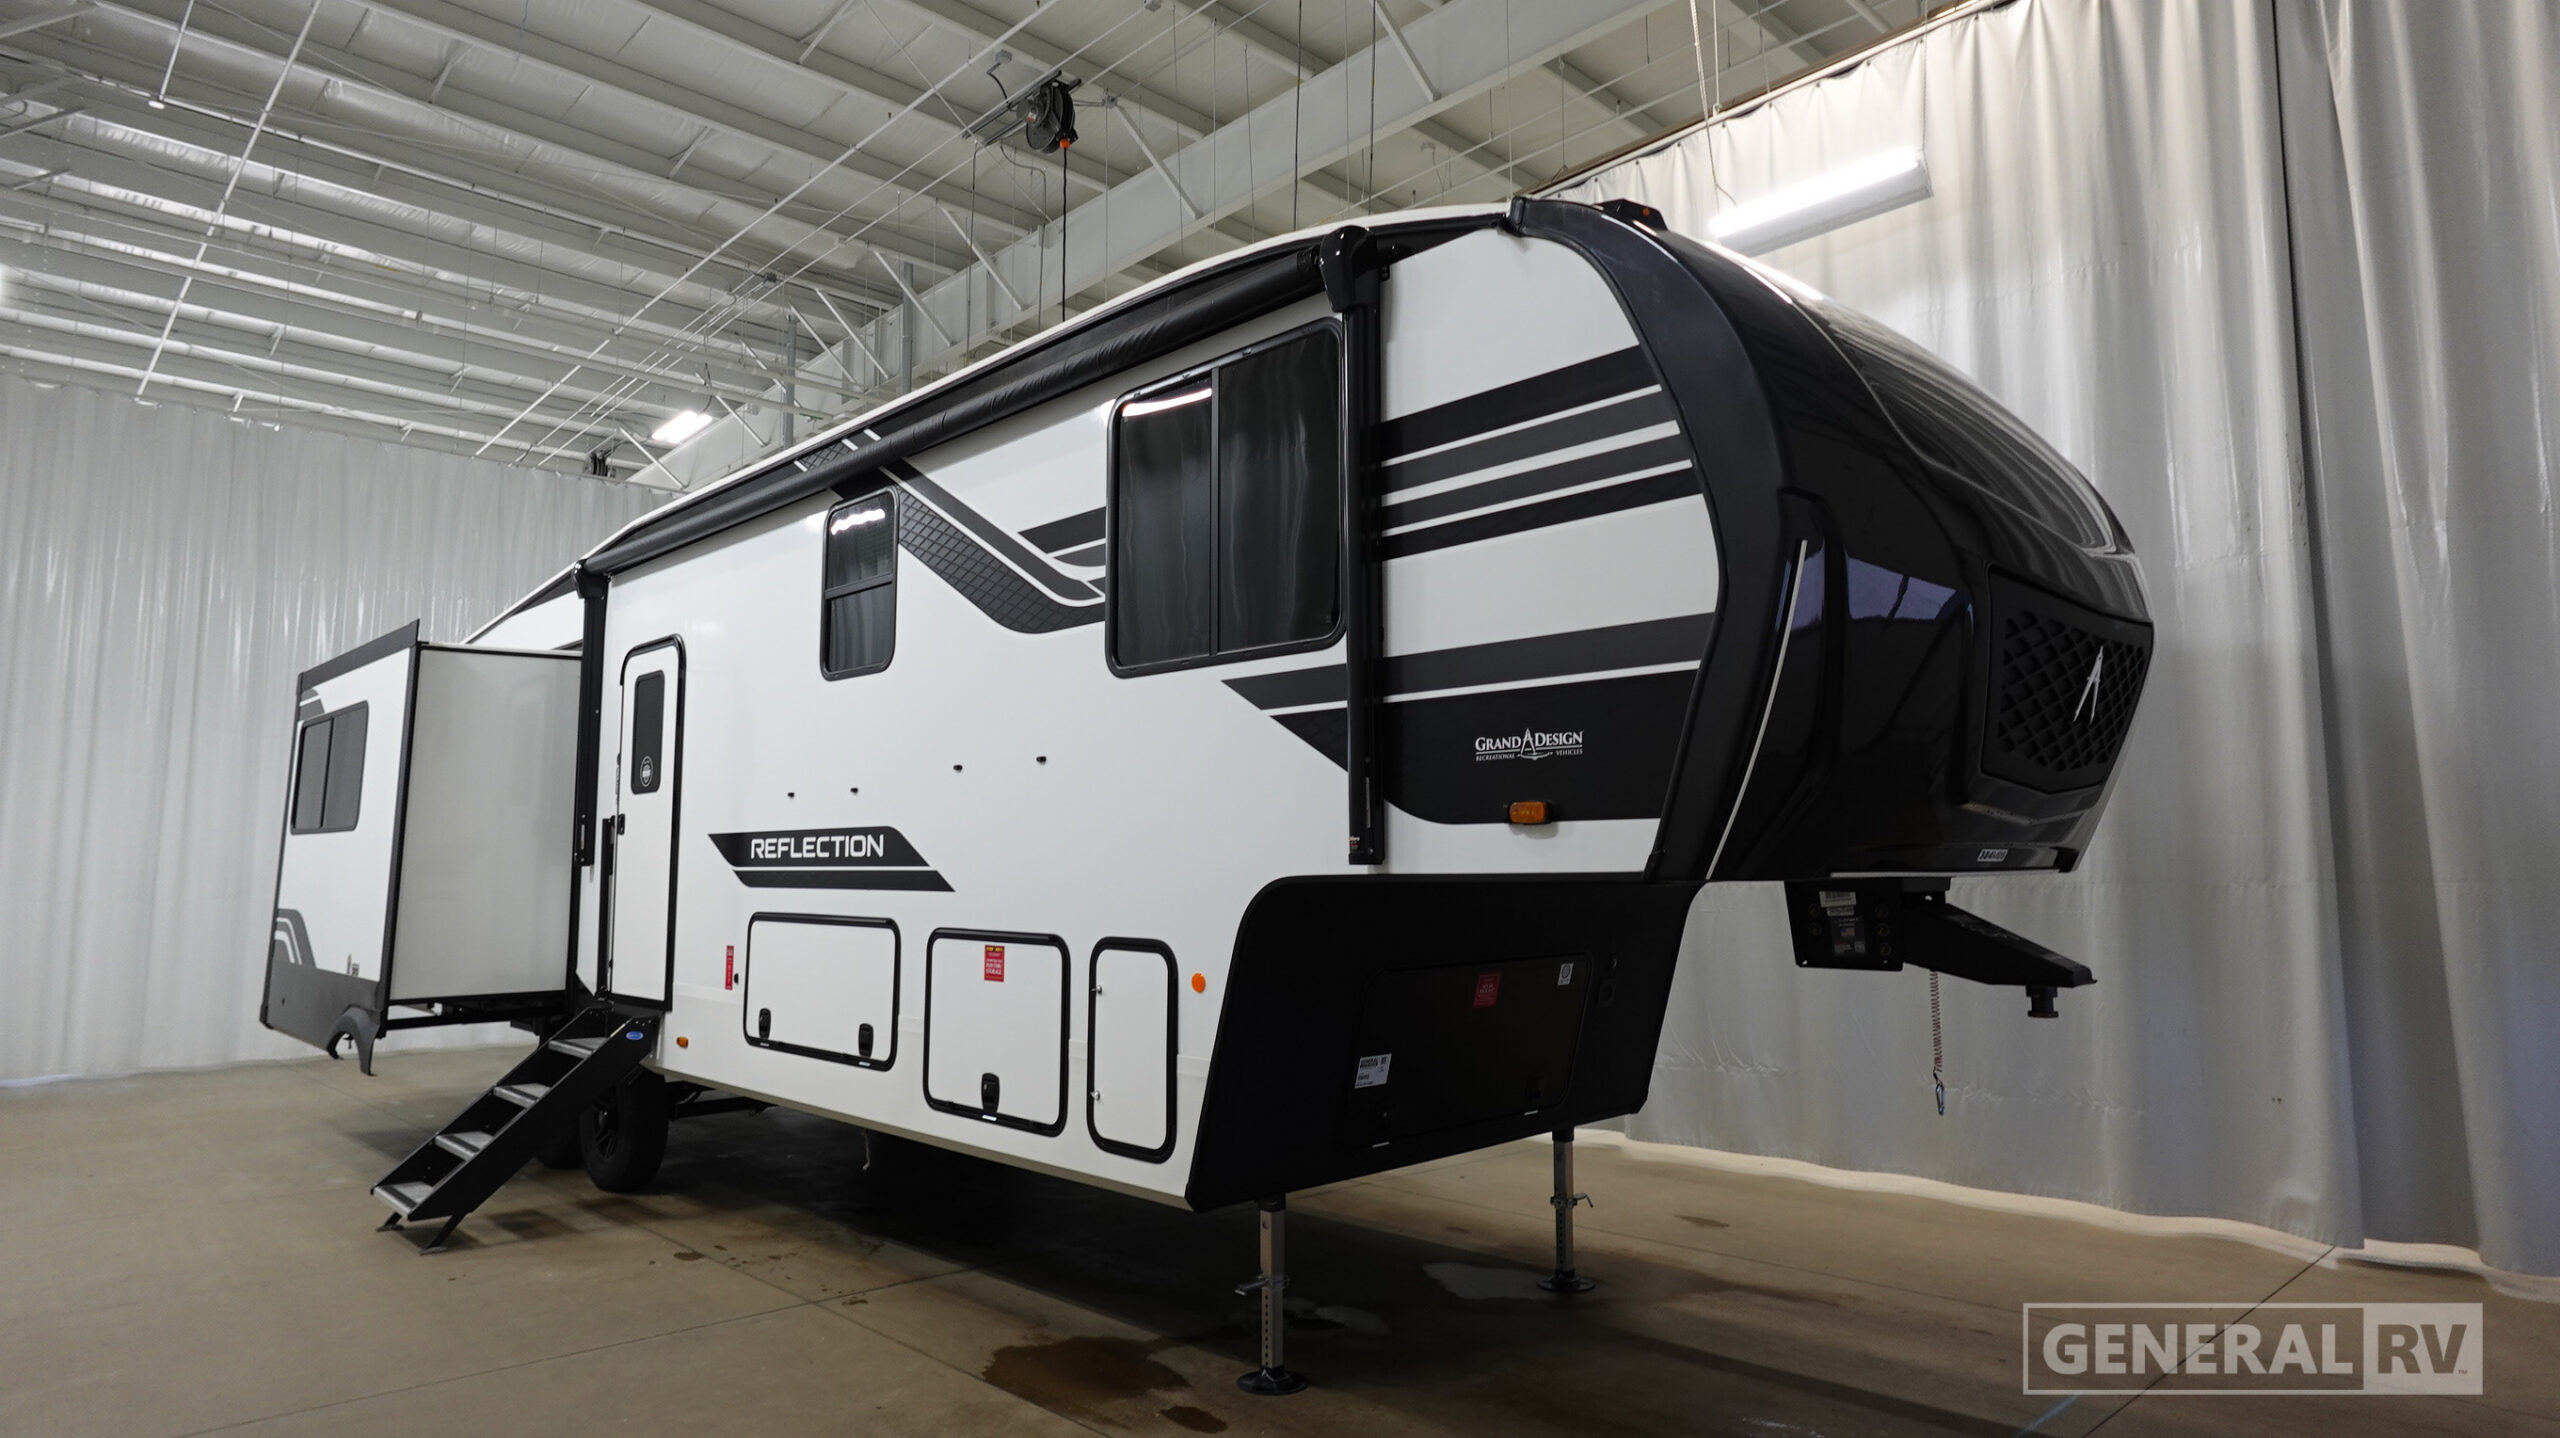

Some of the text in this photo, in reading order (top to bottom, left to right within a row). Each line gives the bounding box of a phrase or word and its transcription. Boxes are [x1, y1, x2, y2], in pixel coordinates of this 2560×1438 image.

[1475, 731, 1583, 751] GRAND DESIGN
[1475, 748, 1583, 761] RECREATIONAL VEHICLES
[750, 834, 884, 859] REFLECTION
